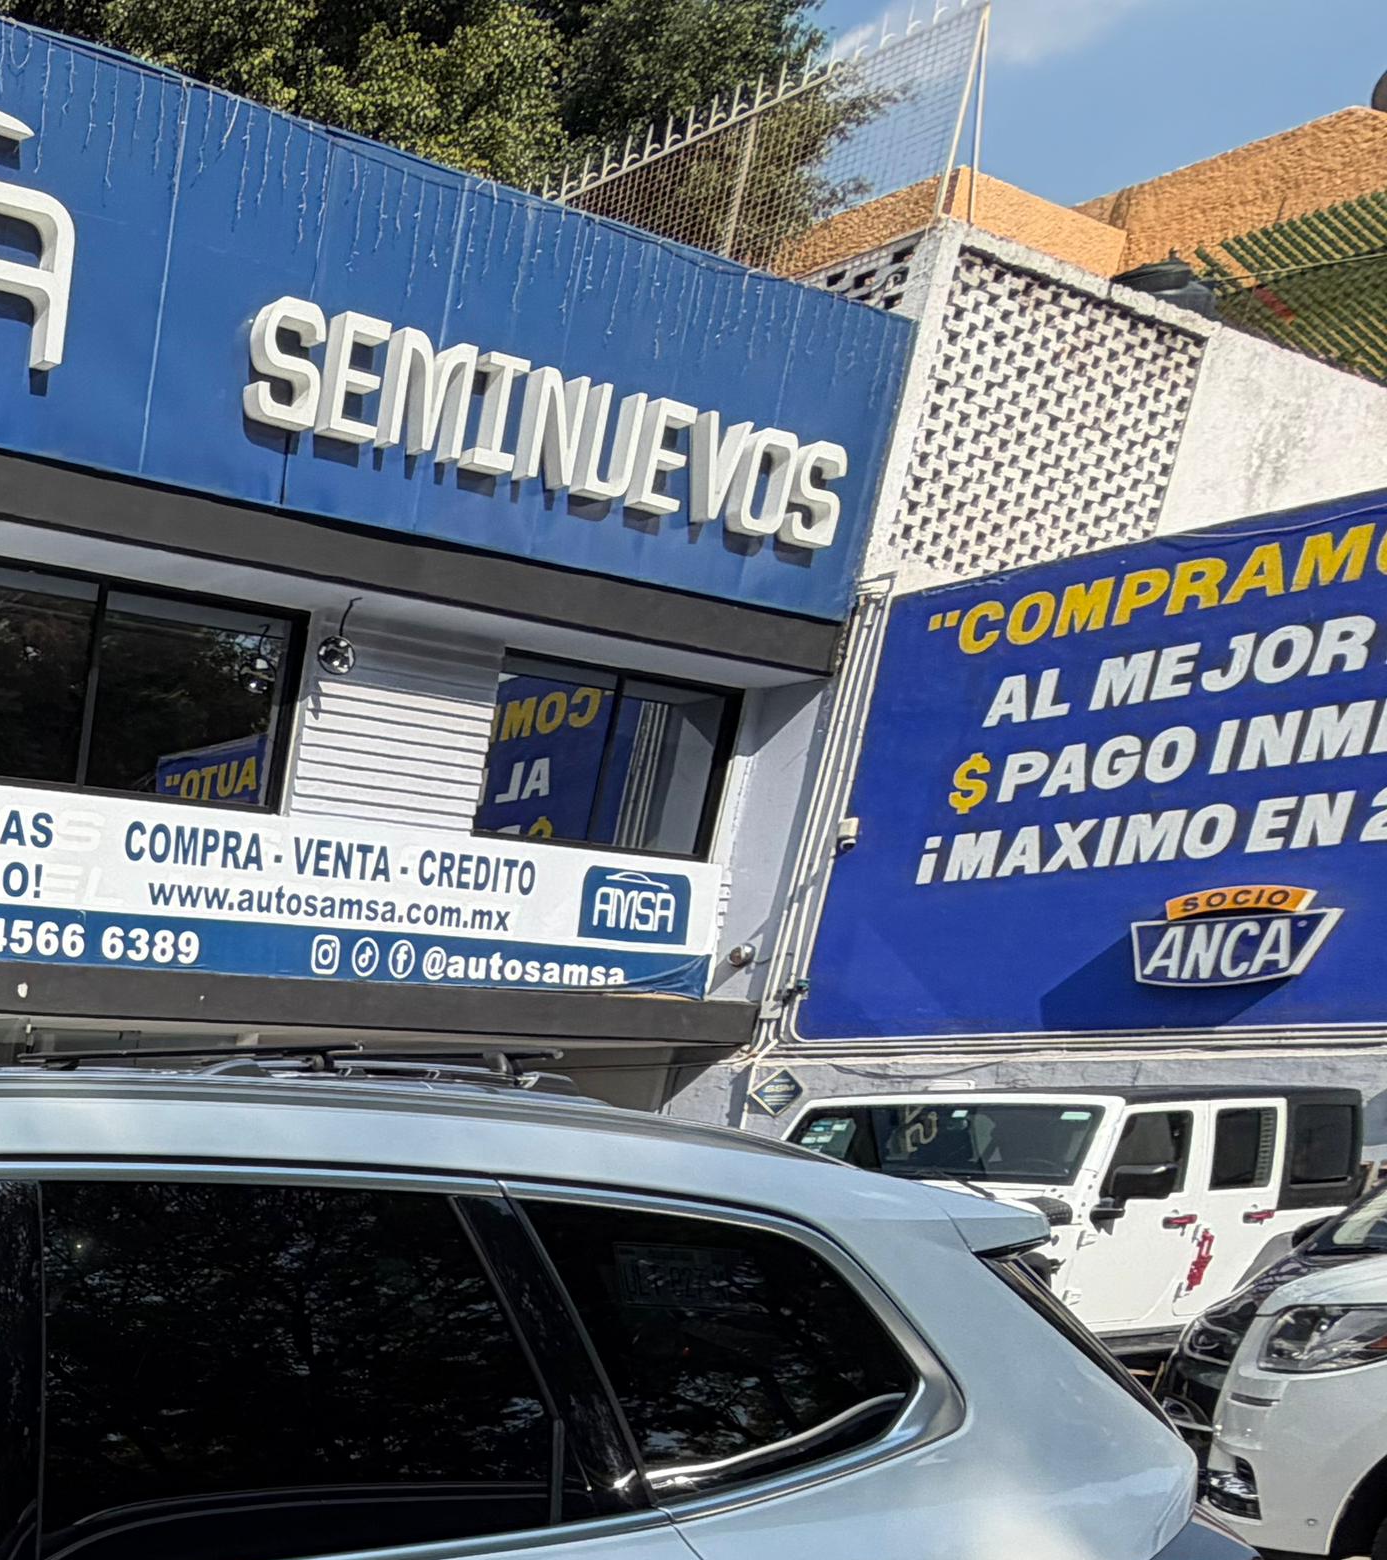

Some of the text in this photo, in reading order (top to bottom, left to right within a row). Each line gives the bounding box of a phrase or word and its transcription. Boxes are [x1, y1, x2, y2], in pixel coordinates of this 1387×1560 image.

[243, 296, 848, 548] SEMINUEVOS
[928, 522, 1387, 654] "COMPRAM
[982, 615, 1376, 728] AL MEJOR
[1244, 790, 1357, 853] EN
[125, 820, 263, 873] COMPRA
[294, 836, 391, 885] VENTA
[418, 848, 536, 897] CREDITO
[148, 876, 510, 934] www.autosamsa.com.mx
[593, 886, 676, 933] AMSA
[1181, 888, 1291, 913] SOCIO
[101, 923, 200, 965] 6389
[423, 945, 627, 989] @autosamsa
[1143, 918, 1292, 980] ANCA
